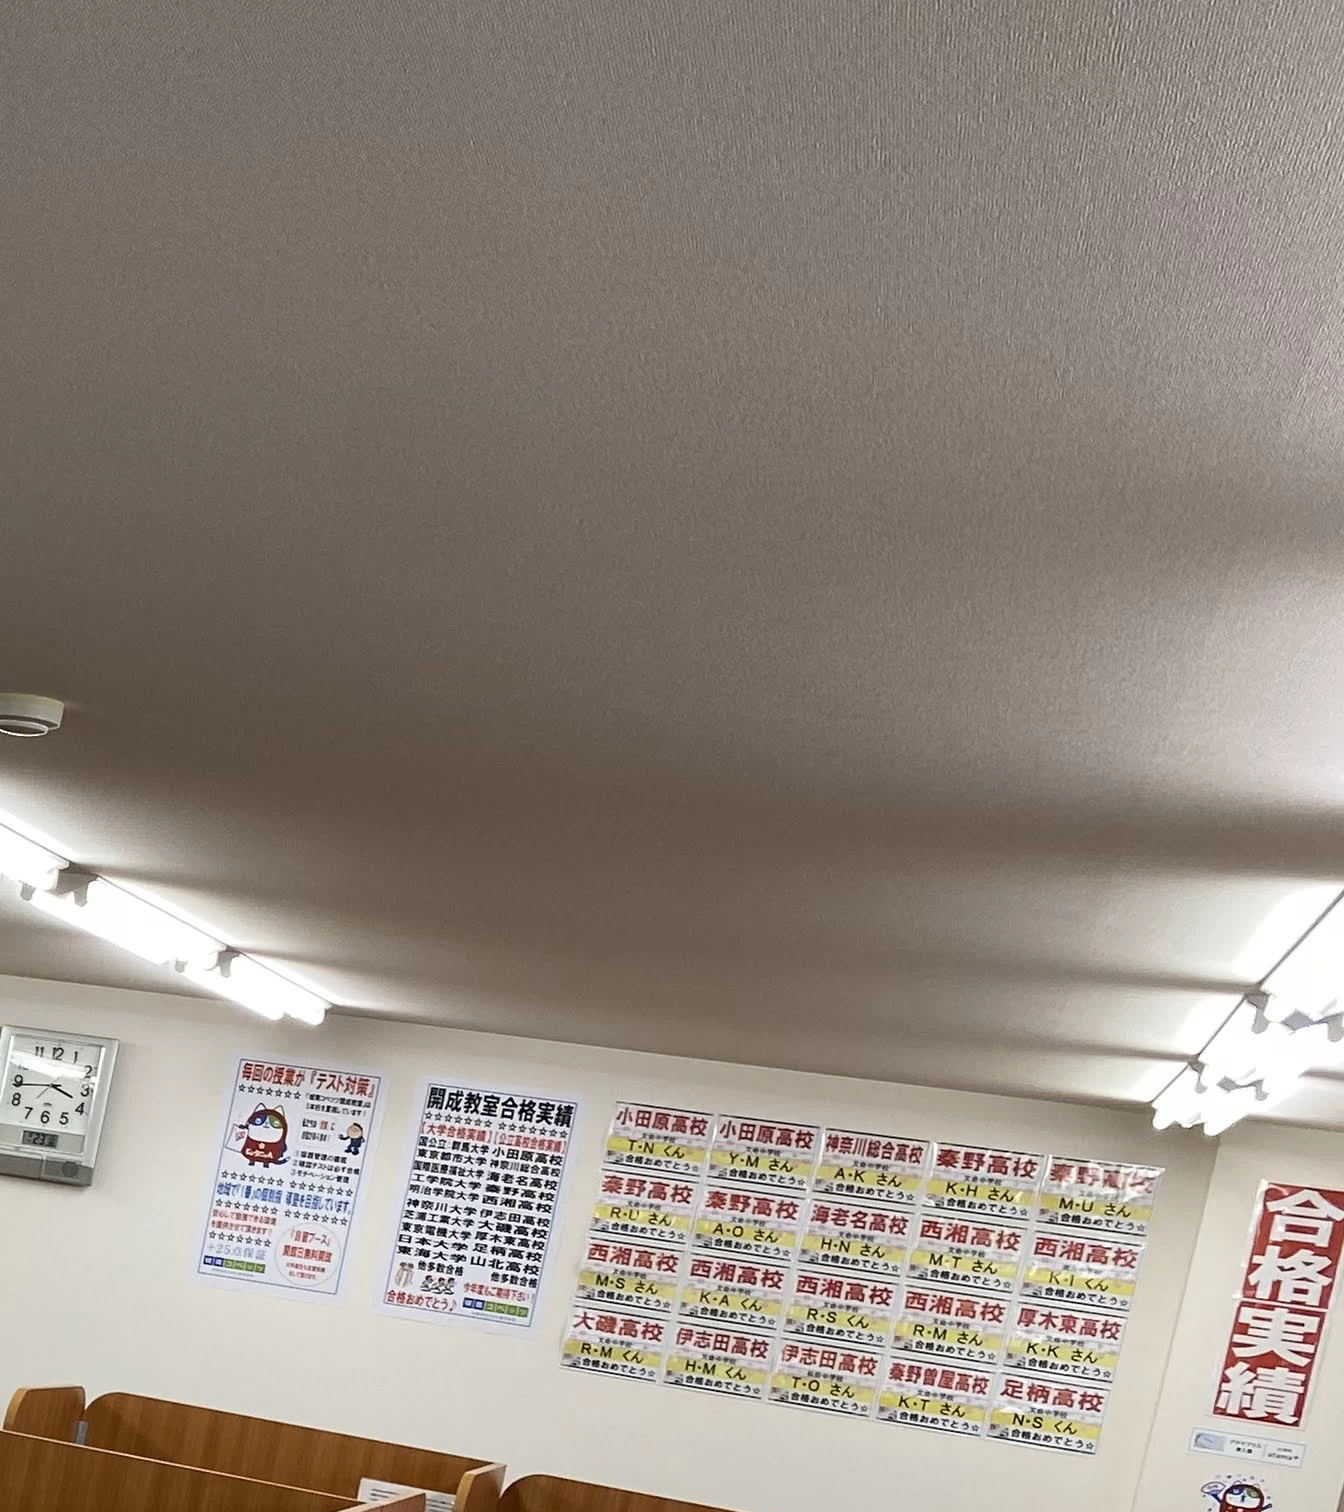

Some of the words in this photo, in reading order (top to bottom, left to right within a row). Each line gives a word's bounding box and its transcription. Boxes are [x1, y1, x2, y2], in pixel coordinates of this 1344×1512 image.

[35, 1046, 44, 1058] 11
[52, 1047, 64, 1060] 12
[11, 1092, 21, 1106] 8
[24, 1106, 33, 1120] 7
[427, 1086, 574, 1128] 開成教室合格実績
[40, 1110, 50, 1124] 6
[59, 1111, 69, 1125] 5
[616, 1107, 709, 1136] 小田原高校
[720, 1120, 815, 1150] 小田原高校
[826, 1134, 924, 1164] 神奈川総合高校
[417, 1149, 487, 1167] 東京都市大学
[492, 1147, 563, 1167] 小田原高校
[663, 1145, 685, 1158] くん
[936, 1148, 1039, 1179] 秦野高校
[412, 1173, 482, 1191] 工学院大学
[602, 1175, 694, 1205] 秦野高校
[987, 1187, 1014, 1203] さん
[407, 1198, 477, 1216] 神奈川大学
[480, 1208, 550, 1228] 伊志田高校
[705, 1191, 800, 1221] 秦野高校
[811, 1204, 909, 1236] 海老名高校
[398, 1234, 468, 1251] 日本大学
[920, 1219, 1022, 1252] 西湘高校
[397, 1246, 467, 1263] 東海大学
[470, 1256, 540, 1275] 山北高校
[587, 1243, 680, 1273] 西湘高校
[1034, 1236, 1139, 1269] 西湘高校
[634, 1280, 659, 1295] さん
[690, 1259, 785, 1290] 西湘高校
[796, 1274, 893, 1307] 西湘高校
[905, 1292, 1007, 1324] 西湘高校
[1214, 1188, 1343, 1425] 合格実績
[573, 1311, 665, 1342] 大磯高校
[1018, 1307, 1123, 1341] 厚木東高校
[676, 1327, 770, 1359] 伊志田高校
[781, 1344, 878, 1376] 伊志田高校
[1001, 1380, 1106, 1413] 足柄高校
[1053, 1420, 1078, 1436] くん
